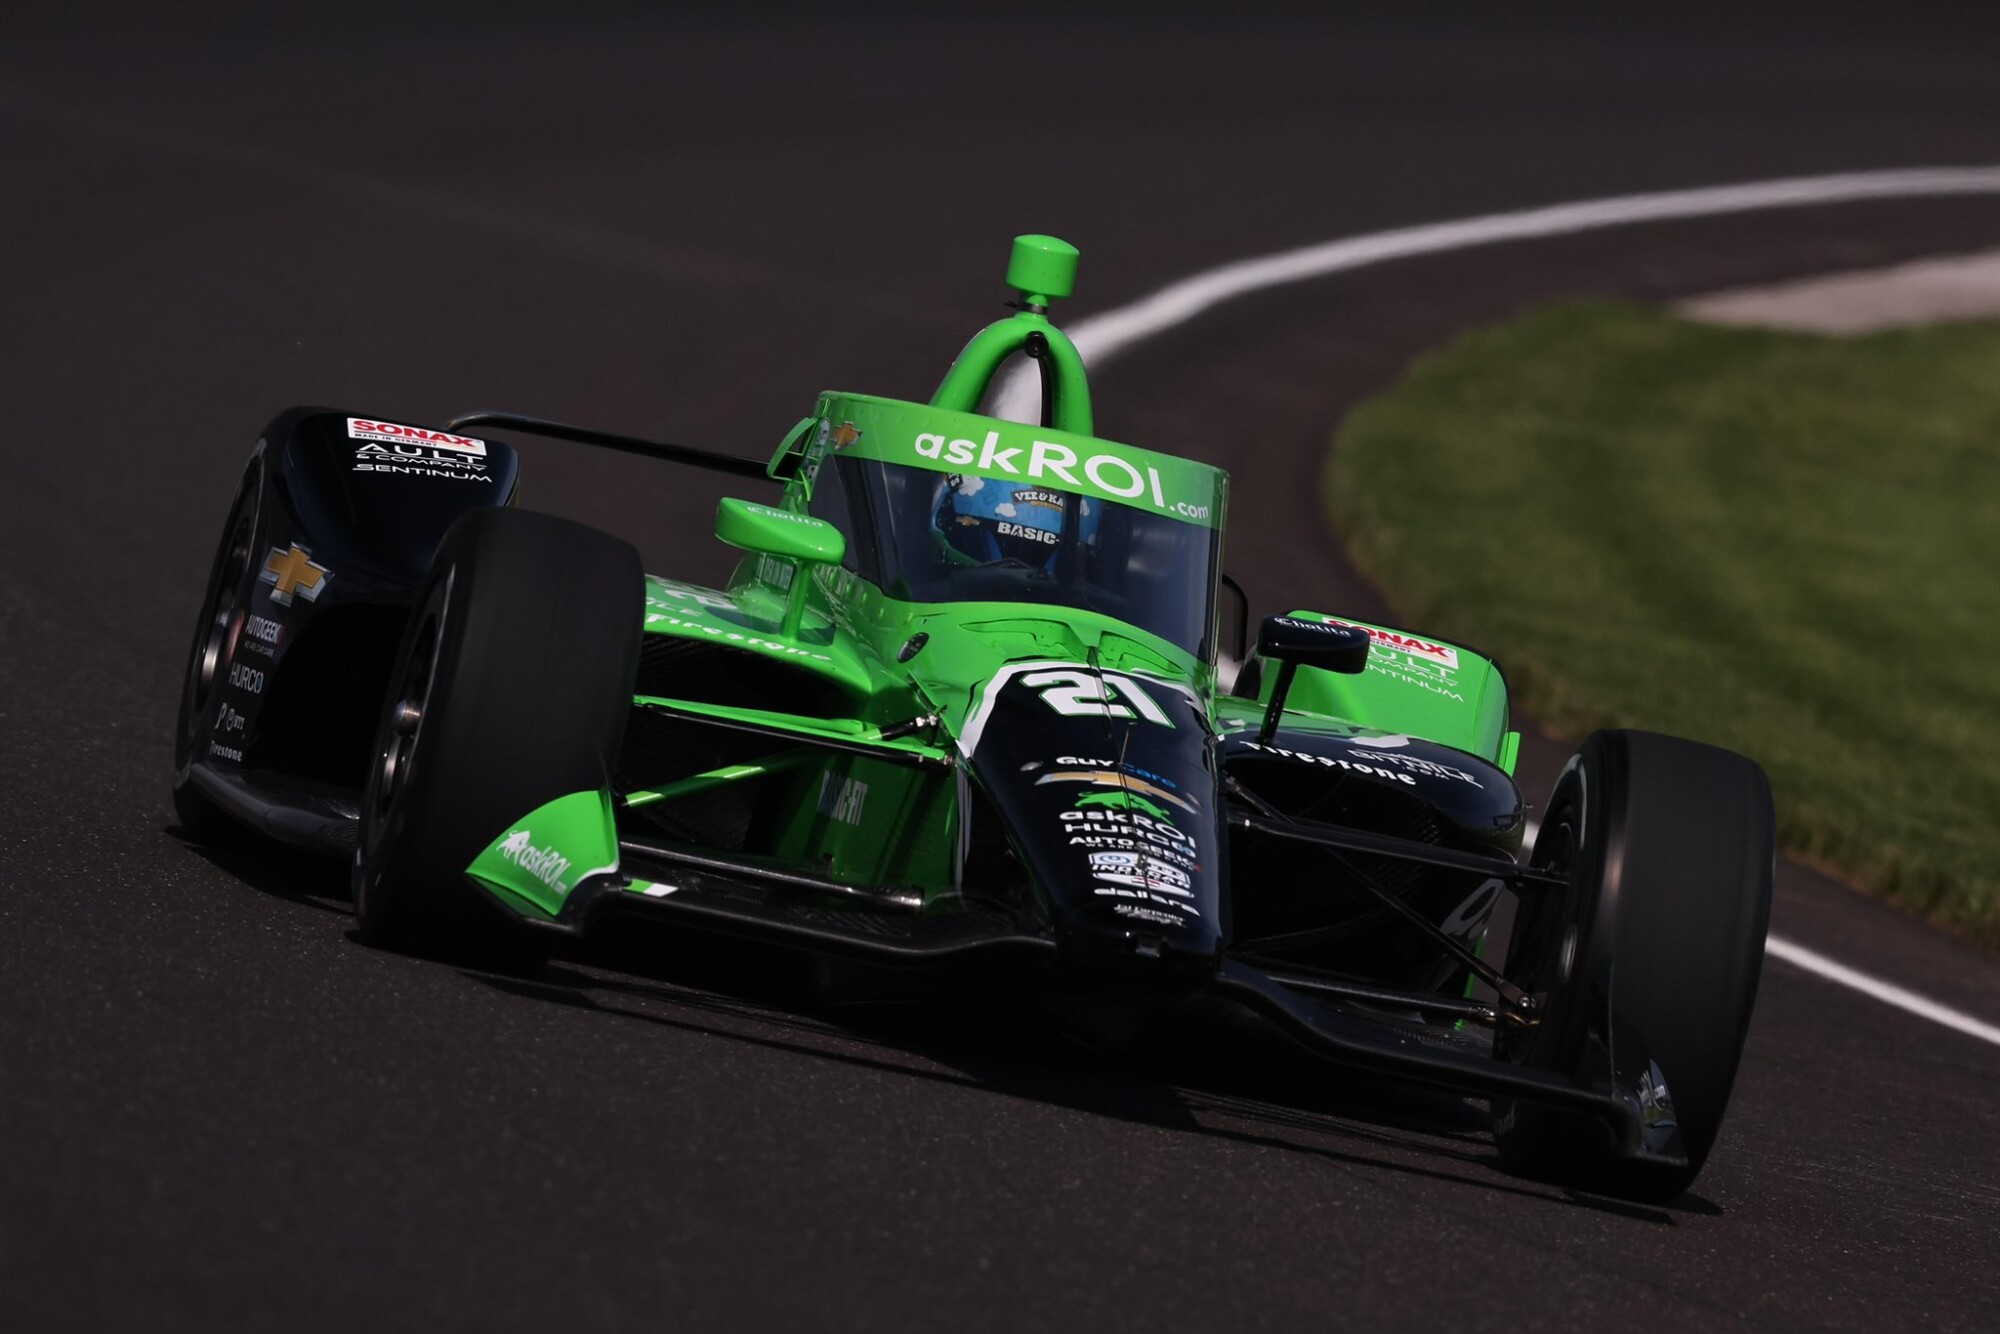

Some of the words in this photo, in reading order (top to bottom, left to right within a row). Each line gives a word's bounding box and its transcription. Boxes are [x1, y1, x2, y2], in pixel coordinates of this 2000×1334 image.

[353, 420, 475, 447] SONAX
[357, 442, 483, 464] AULT
[375, 454, 487, 471] COMPANY
[352, 463, 492, 483] SENTINUM
[244, 614, 281, 644] AUTOGEEK
[645, 612, 832, 661] Firestone
[228, 661, 264, 694] HURCO
[1368, 655, 1458, 687] OMPANY
[1369, 646, 1456, 677] ULT
[1019, 668, 1176, 729] 21
[1366, 663, 1464, 702] NTINUM
[1239, 740, 1417, 786] Firestone
[1059, 810, 1196, 849] askROI
[1064, 823, 1196, 859] HURCO
[1069, 836, 1193, 868] AUTOGEEK
[1094, 887, 1200, 917] dallara
